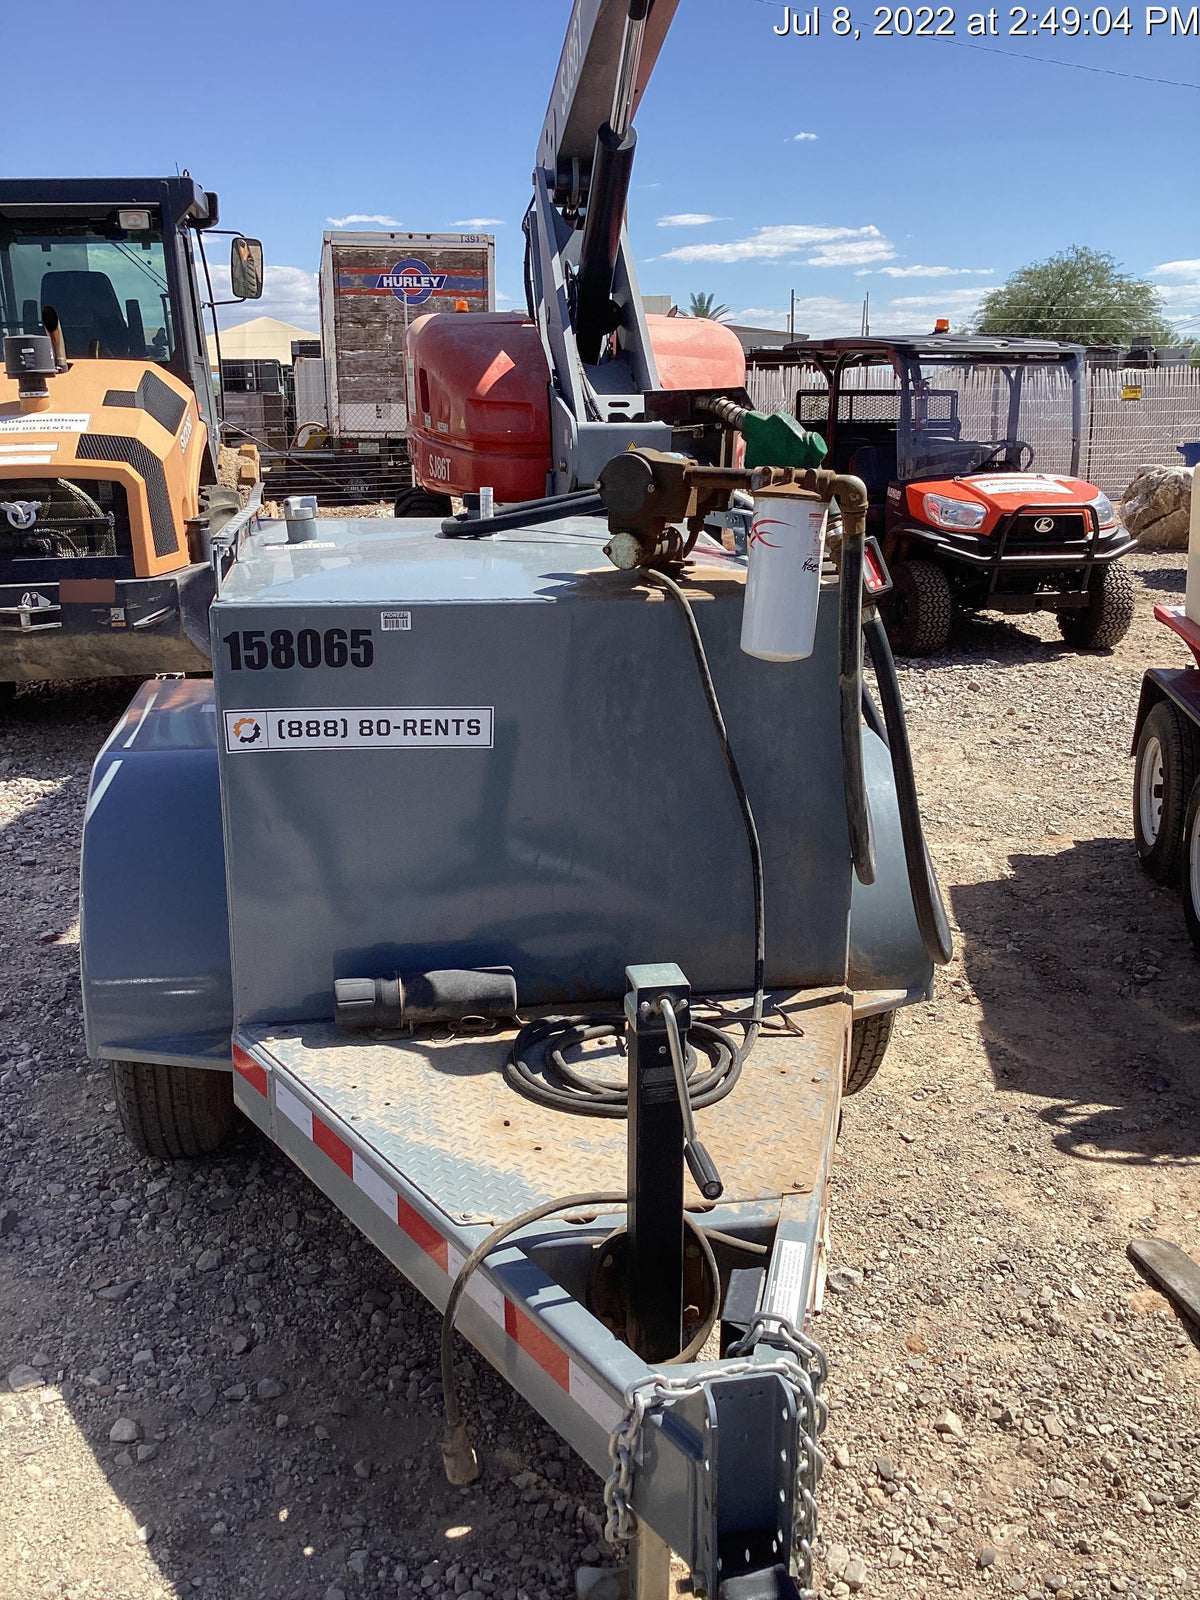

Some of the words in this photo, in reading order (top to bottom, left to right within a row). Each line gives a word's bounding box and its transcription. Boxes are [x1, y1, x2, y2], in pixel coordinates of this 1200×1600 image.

[383, 276, 441, 287] HURLEY
[428, 454, 451, 481] SJ86T
[222, 628, 374, 671] 158065
[277, 718, 348, 740] (888)
[358, 718, 482, 737] 80-RENTS
